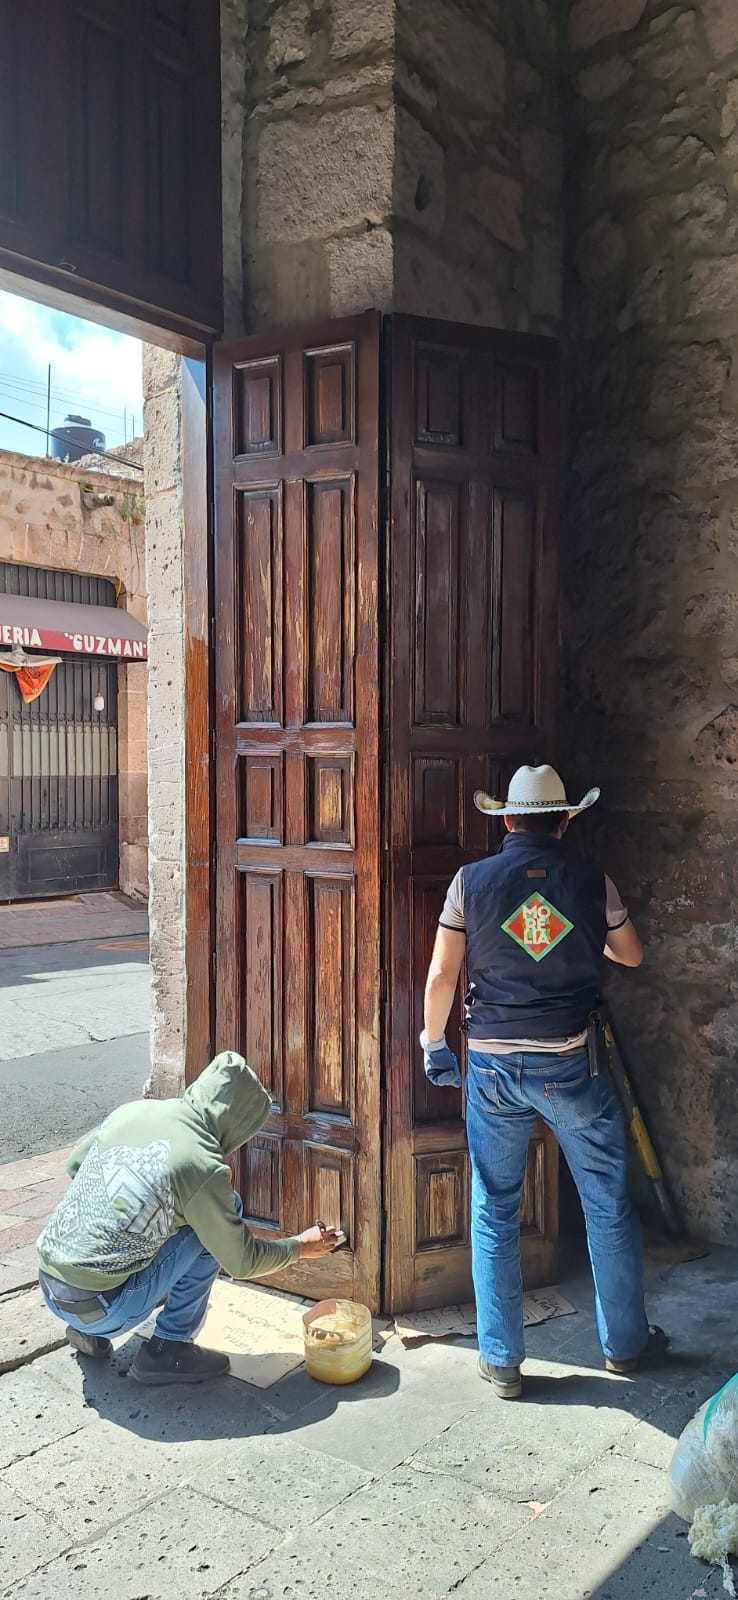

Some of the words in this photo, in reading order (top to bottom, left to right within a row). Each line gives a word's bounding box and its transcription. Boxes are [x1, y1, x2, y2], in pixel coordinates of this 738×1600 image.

[0, 625, 42, 647] ERIA
[522, 905, 552, 919] MO
[524, 918, 547, 931] RE
[523, 930, 551, 945] LIA
